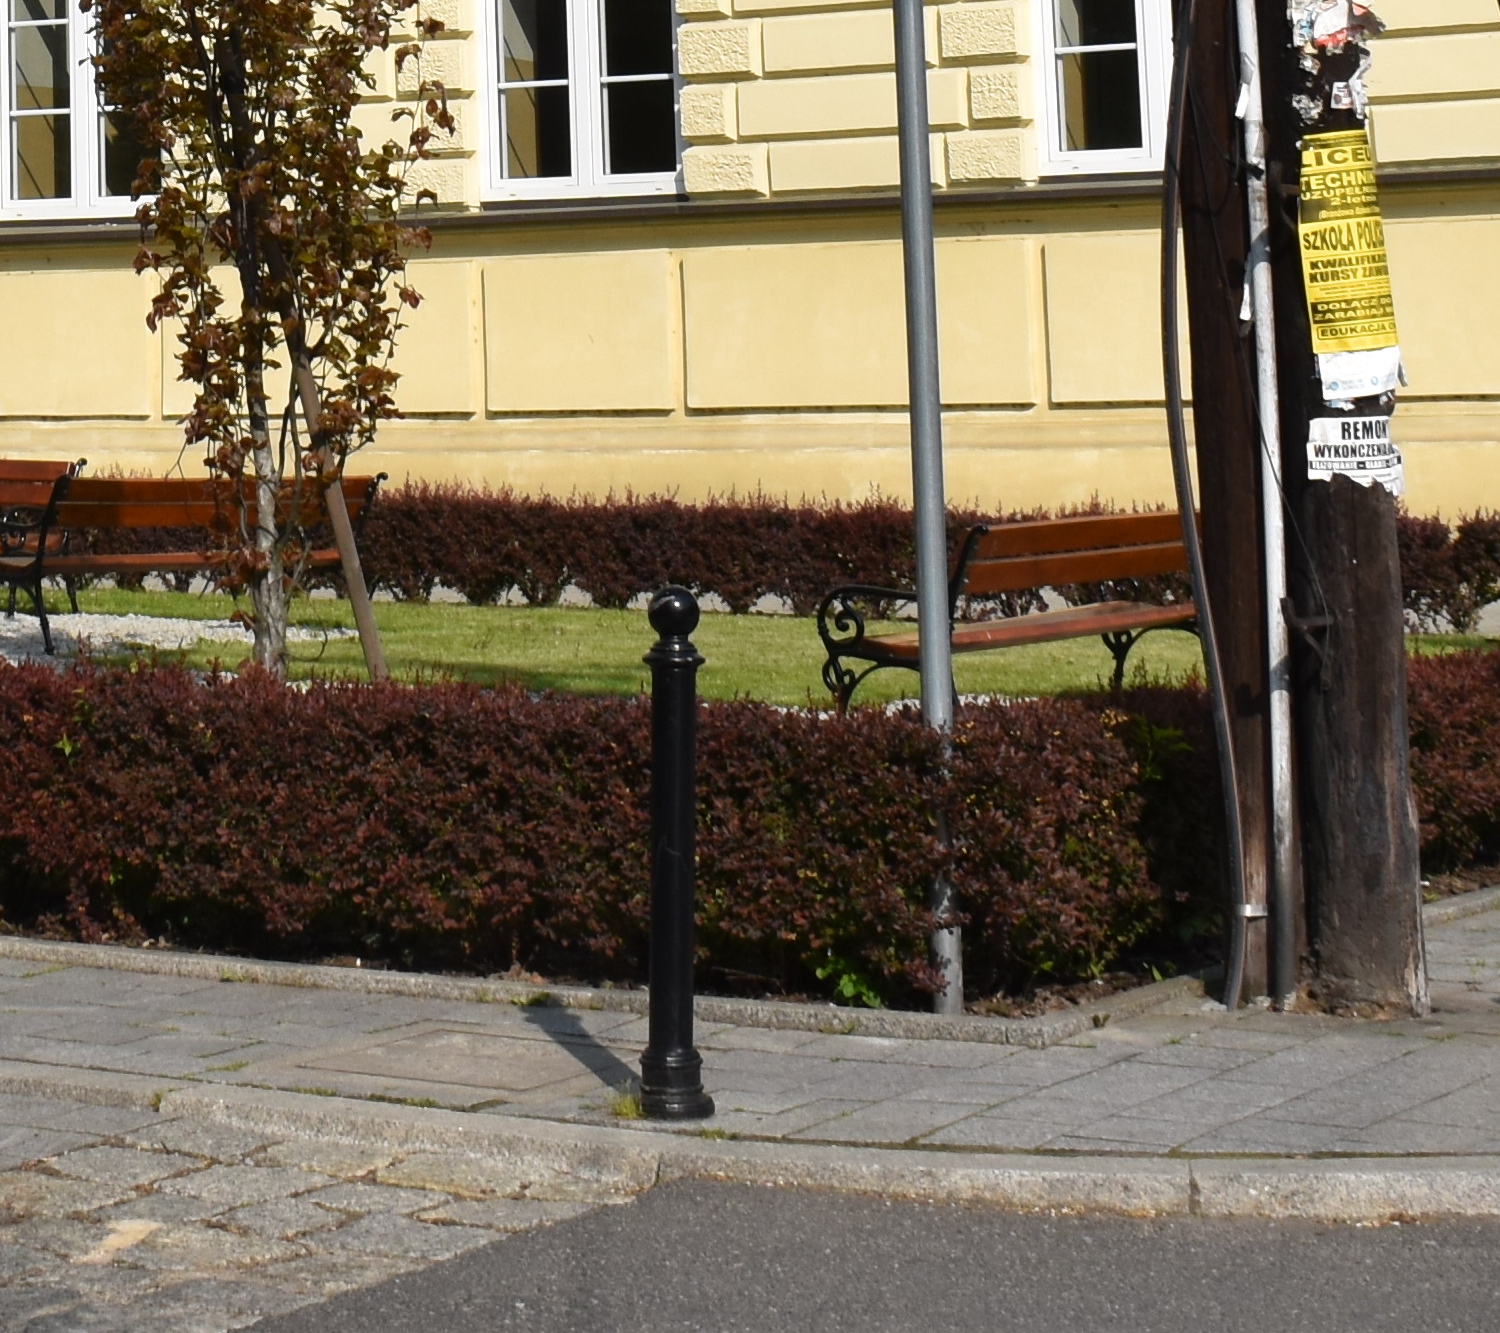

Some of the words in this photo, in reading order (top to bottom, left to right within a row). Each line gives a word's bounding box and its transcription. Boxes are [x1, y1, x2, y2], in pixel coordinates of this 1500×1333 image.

[1303, 222, 1355, 251] SZKOŁA
[1309, 268, 1359, 284] KURSY
[1321, 322, 1387, 337] EDUKACJA
